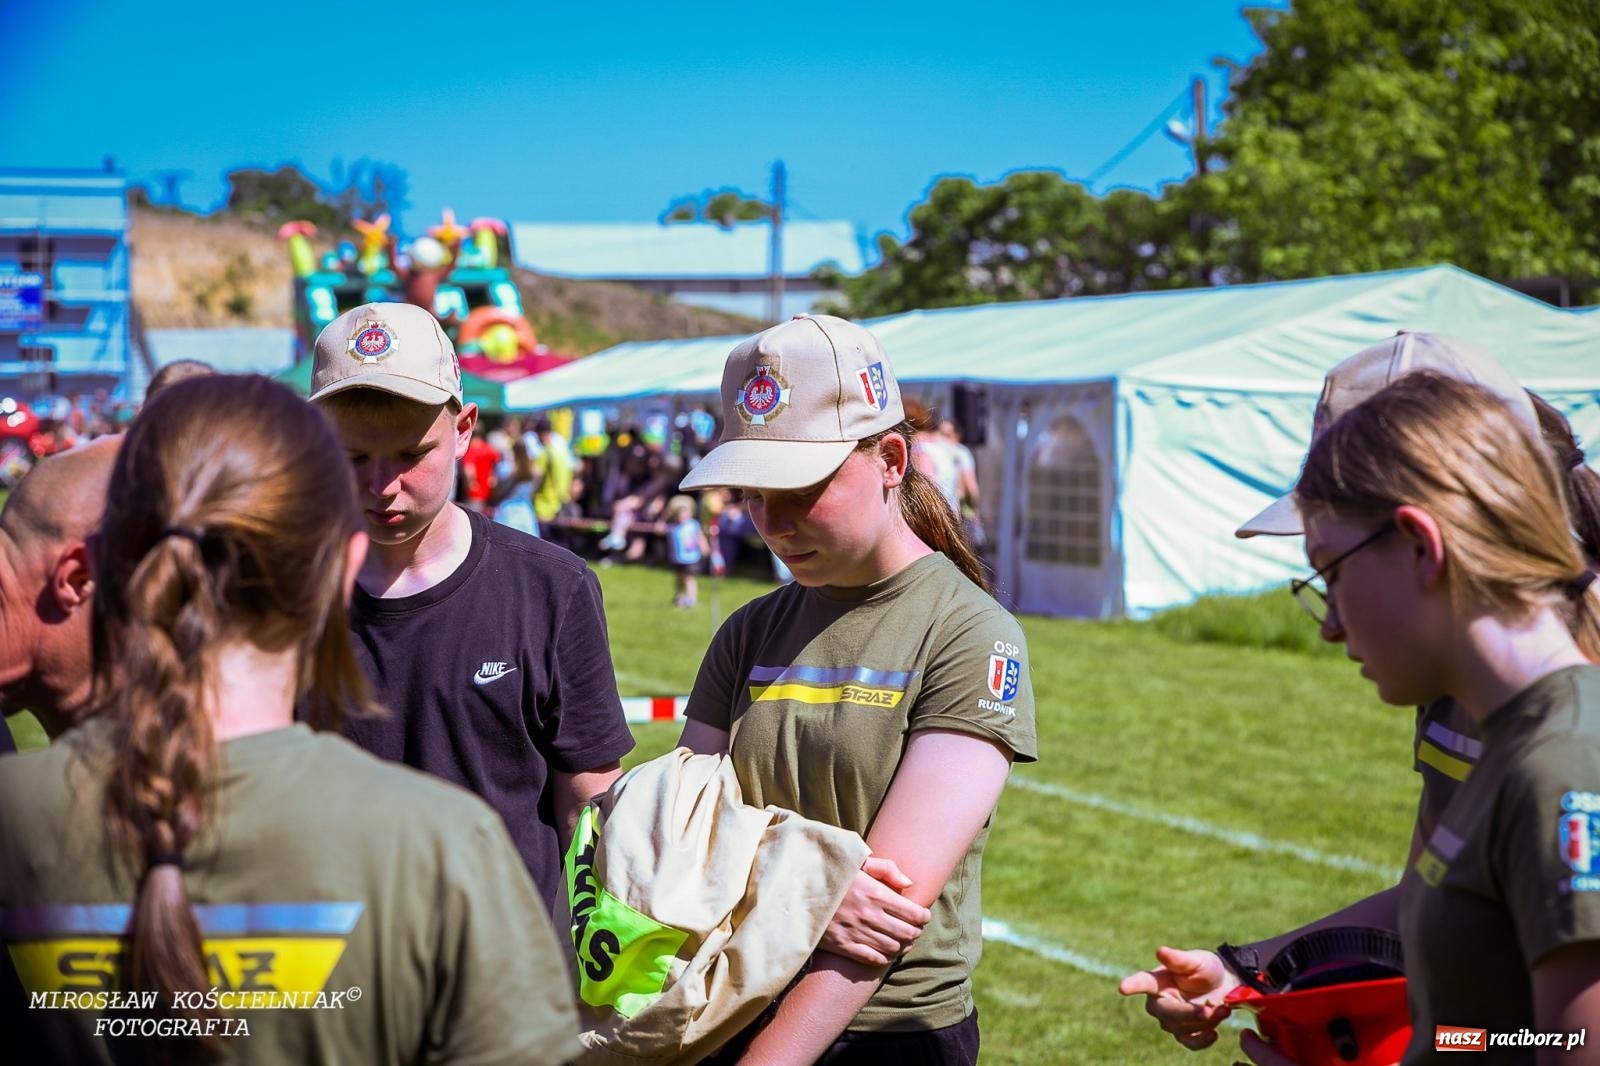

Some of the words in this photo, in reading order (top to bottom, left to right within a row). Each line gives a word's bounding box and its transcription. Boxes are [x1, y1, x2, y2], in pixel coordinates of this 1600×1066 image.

[994, 640, 1019, 657] OSP
[480, 662, 507, 675] NIKE
[978, 698, 1016, 716] RUDNIK
